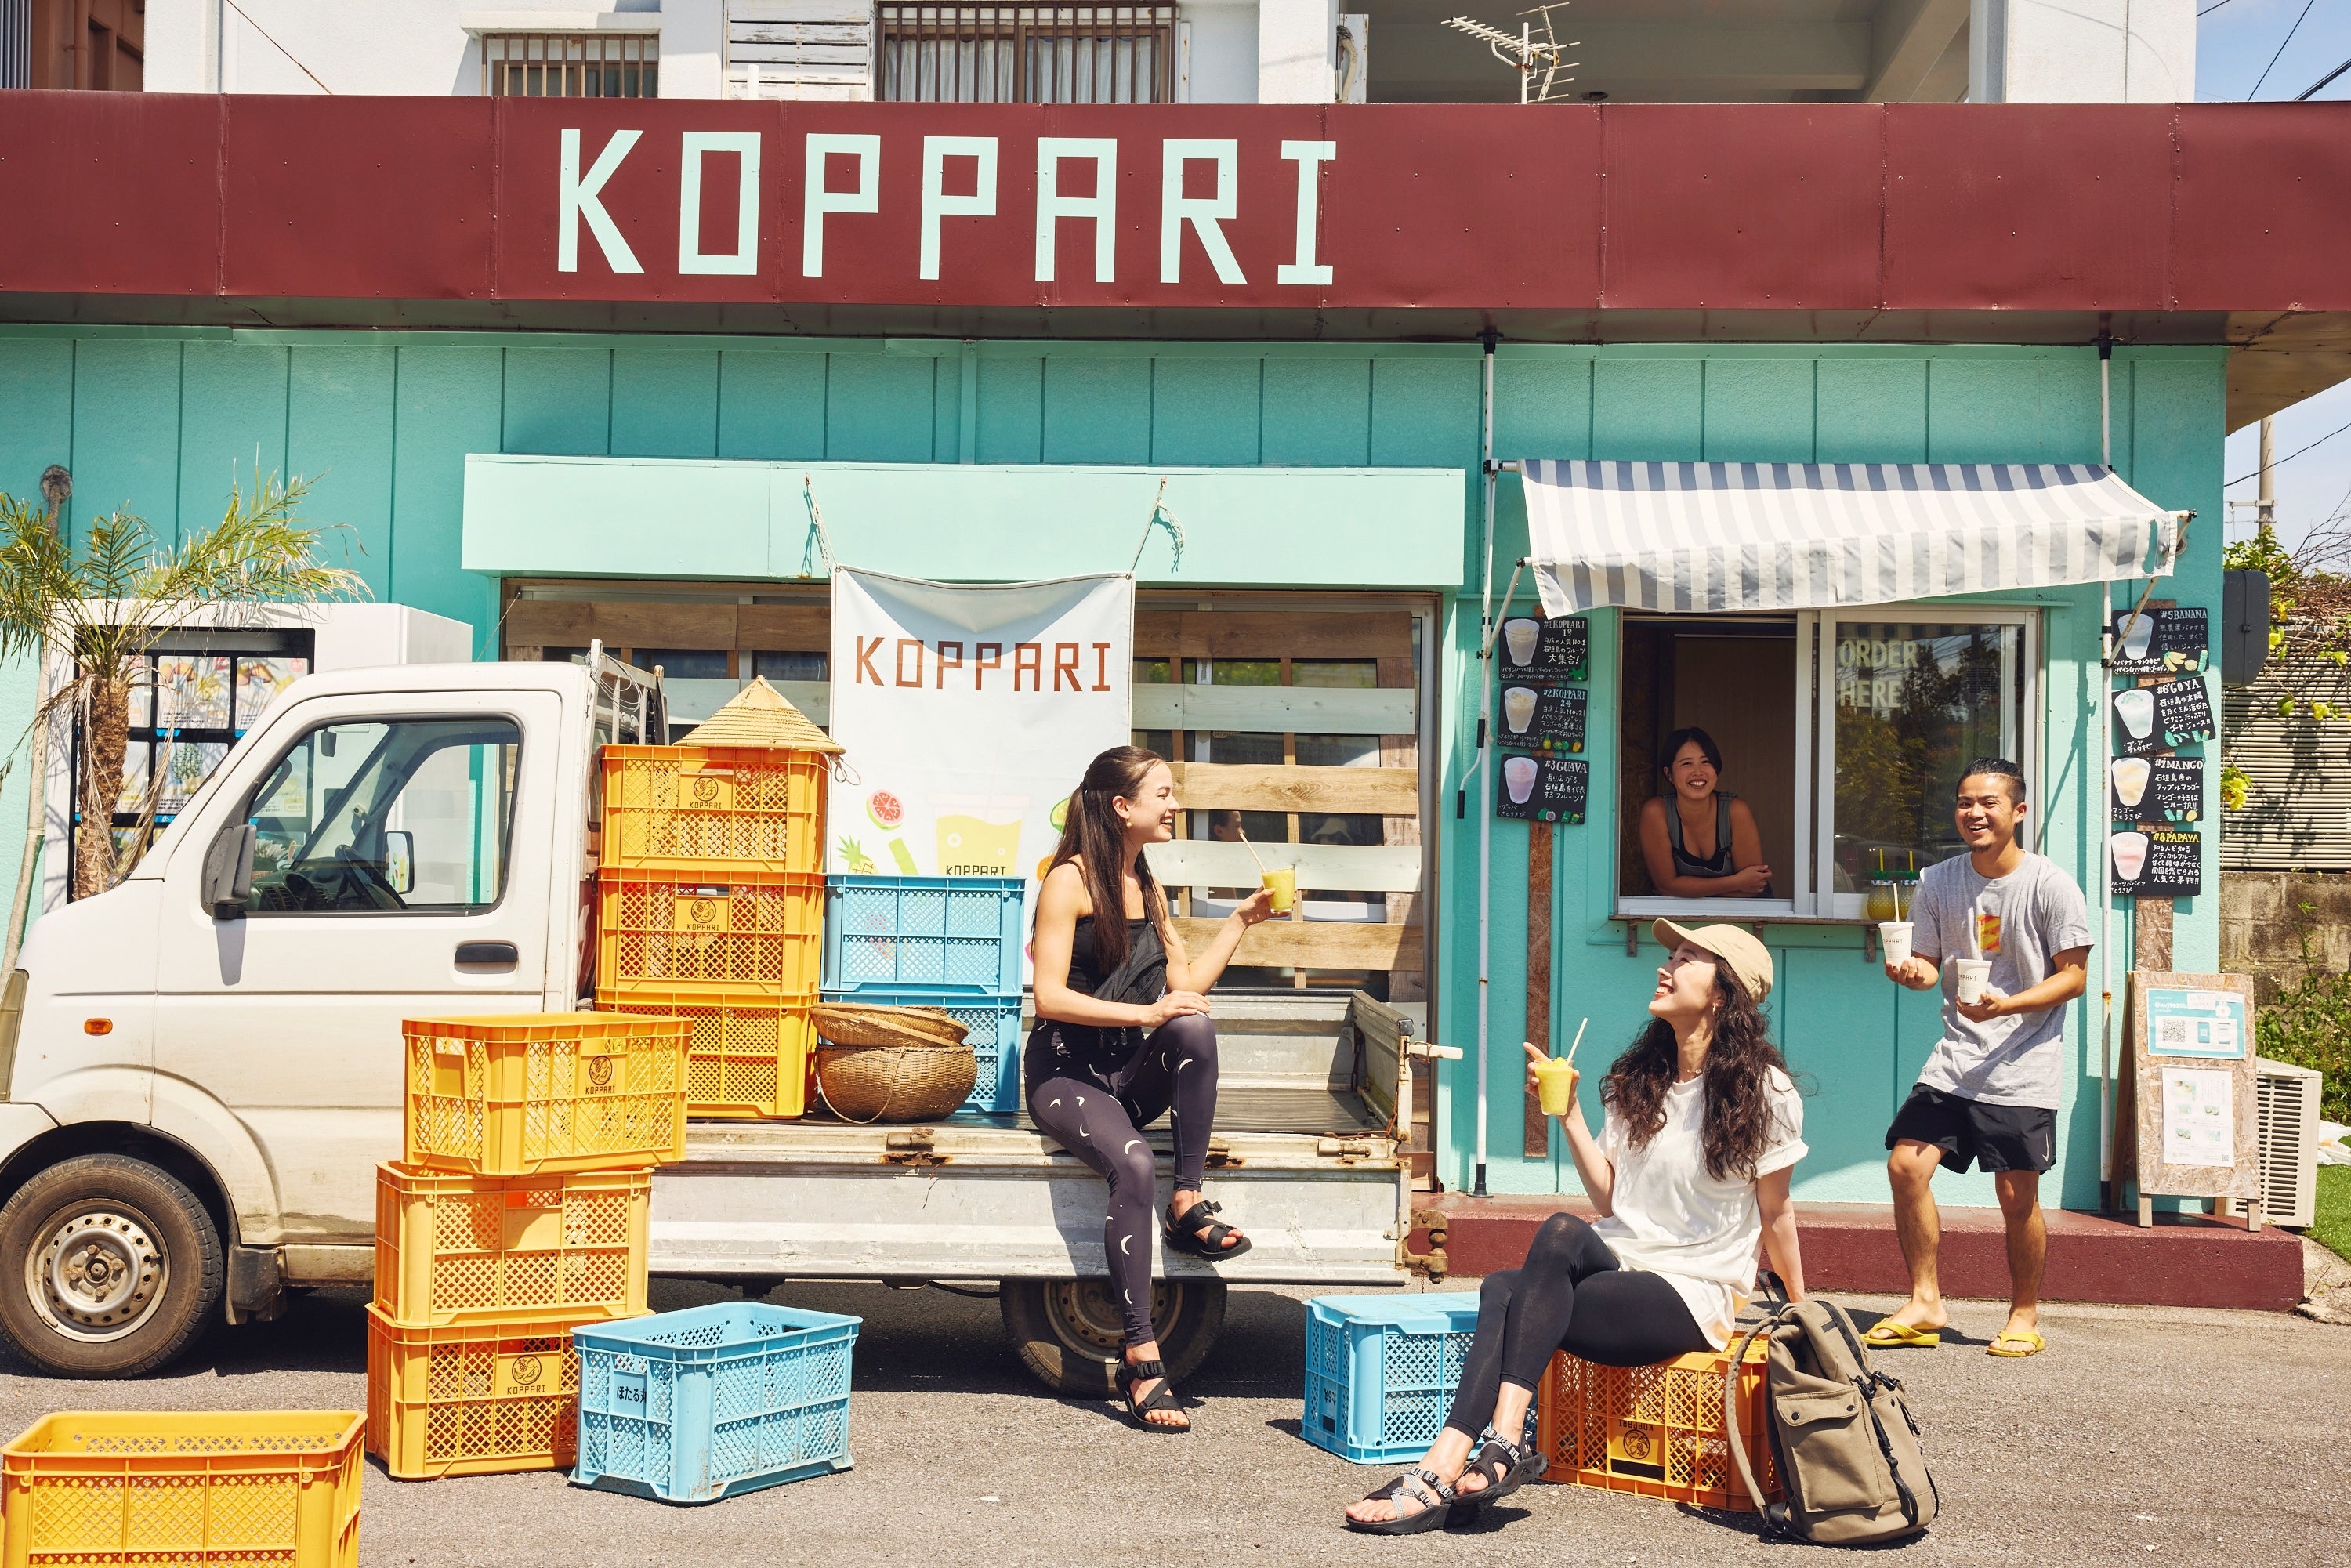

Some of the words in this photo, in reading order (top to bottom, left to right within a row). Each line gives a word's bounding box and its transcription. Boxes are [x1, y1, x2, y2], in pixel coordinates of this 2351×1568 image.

[557, 128, 1336, 286] KOPPARI
[1838, 639, 1919, 668] ORDER
[856, 636, 1111, 692] KOPPARI
[1840, 679, 1903, 708] HERE
[2159, 690, 2204, 708] 石垣島の太陽
[2163, 711, 2206, 725] ビタミンたっぷり
[2154, 773, 2192, 781] 石垣島産の
[1544, 783, 1586, 795] 石垣島を代表
[2157, 782, 2200, 791] アップルマンゴー
[585, 1085, 615, 1095] KOPPARI
[507, 1385, 545, 1395] KOPPARI
[1618, 1419, 1654, 1432] KOPPARI
